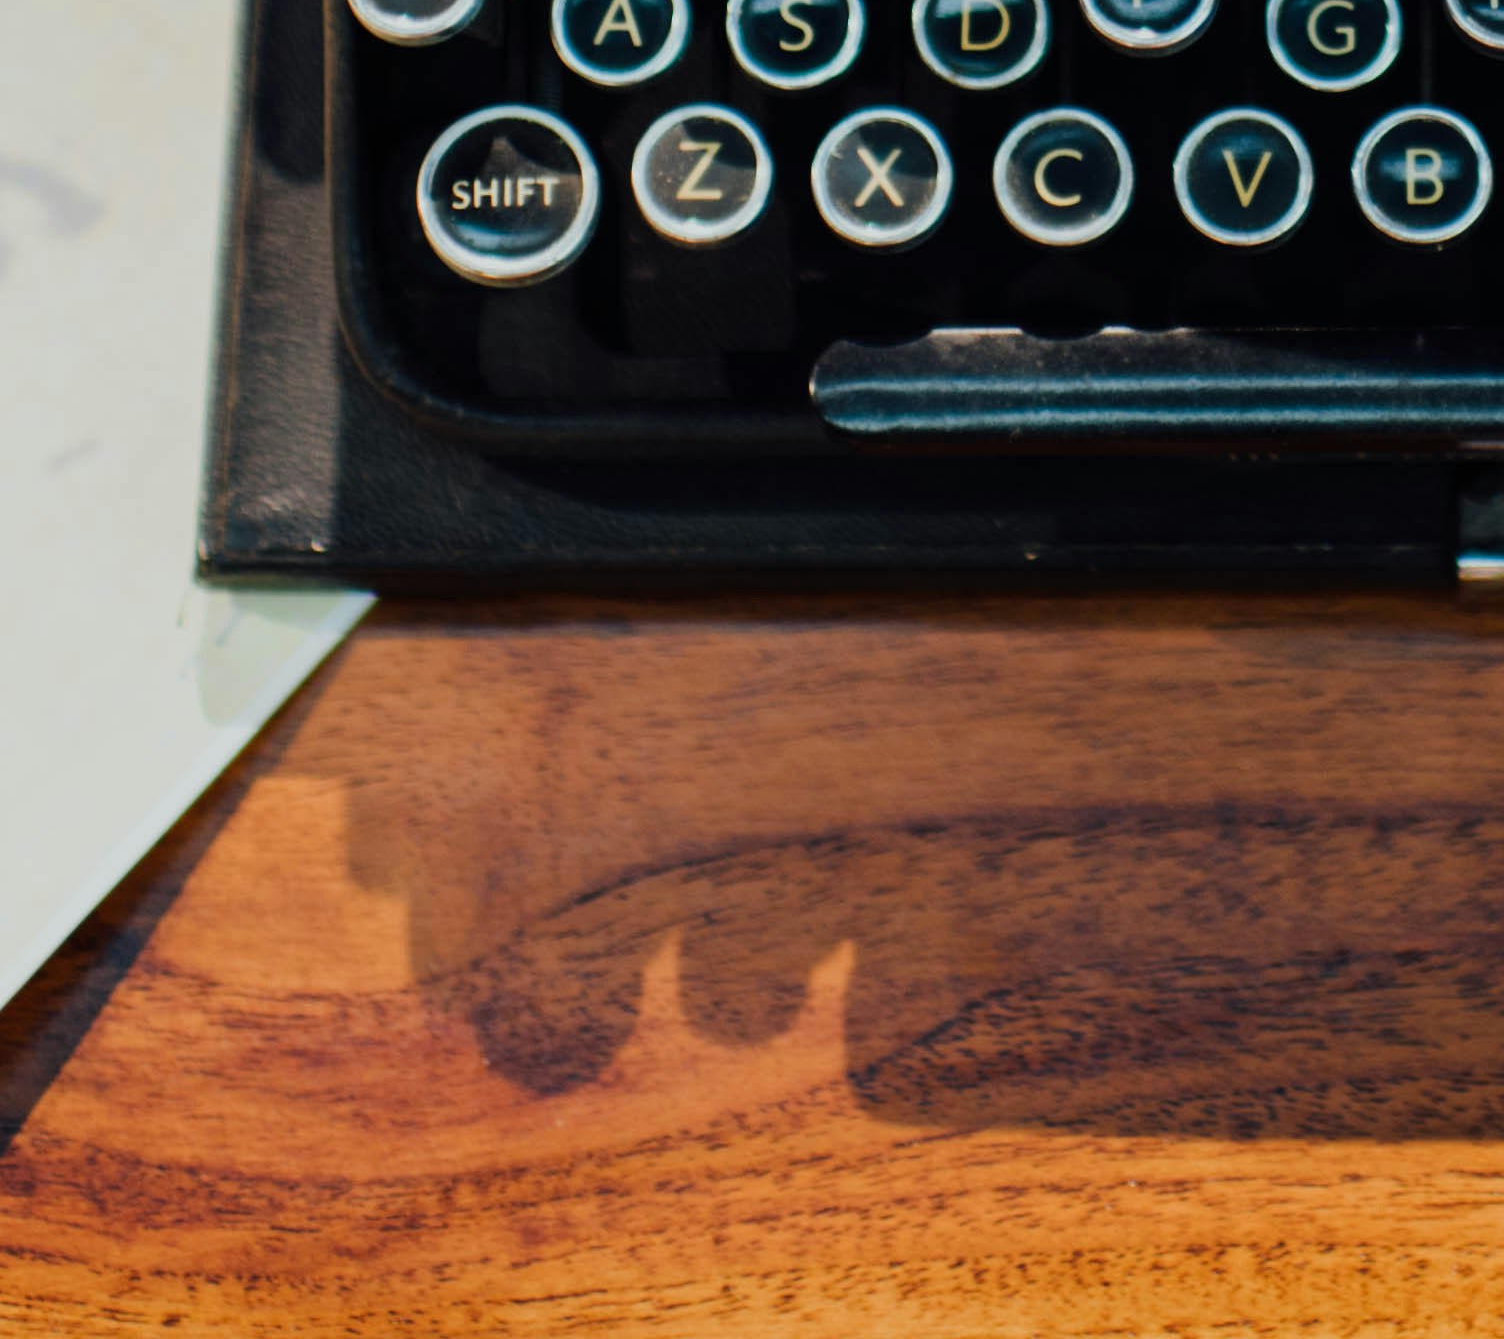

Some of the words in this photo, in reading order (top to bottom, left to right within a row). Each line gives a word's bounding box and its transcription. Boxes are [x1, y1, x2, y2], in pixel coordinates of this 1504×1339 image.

[450, 175, 562, 211] SHIFT
[674, 140, 724, 201] Z
[853, 146, 906, 208] X
[1033, 148, 1085, 208] C
[1222, 149, 1274, 209] V
[1403, 147, 1445, 206] B
